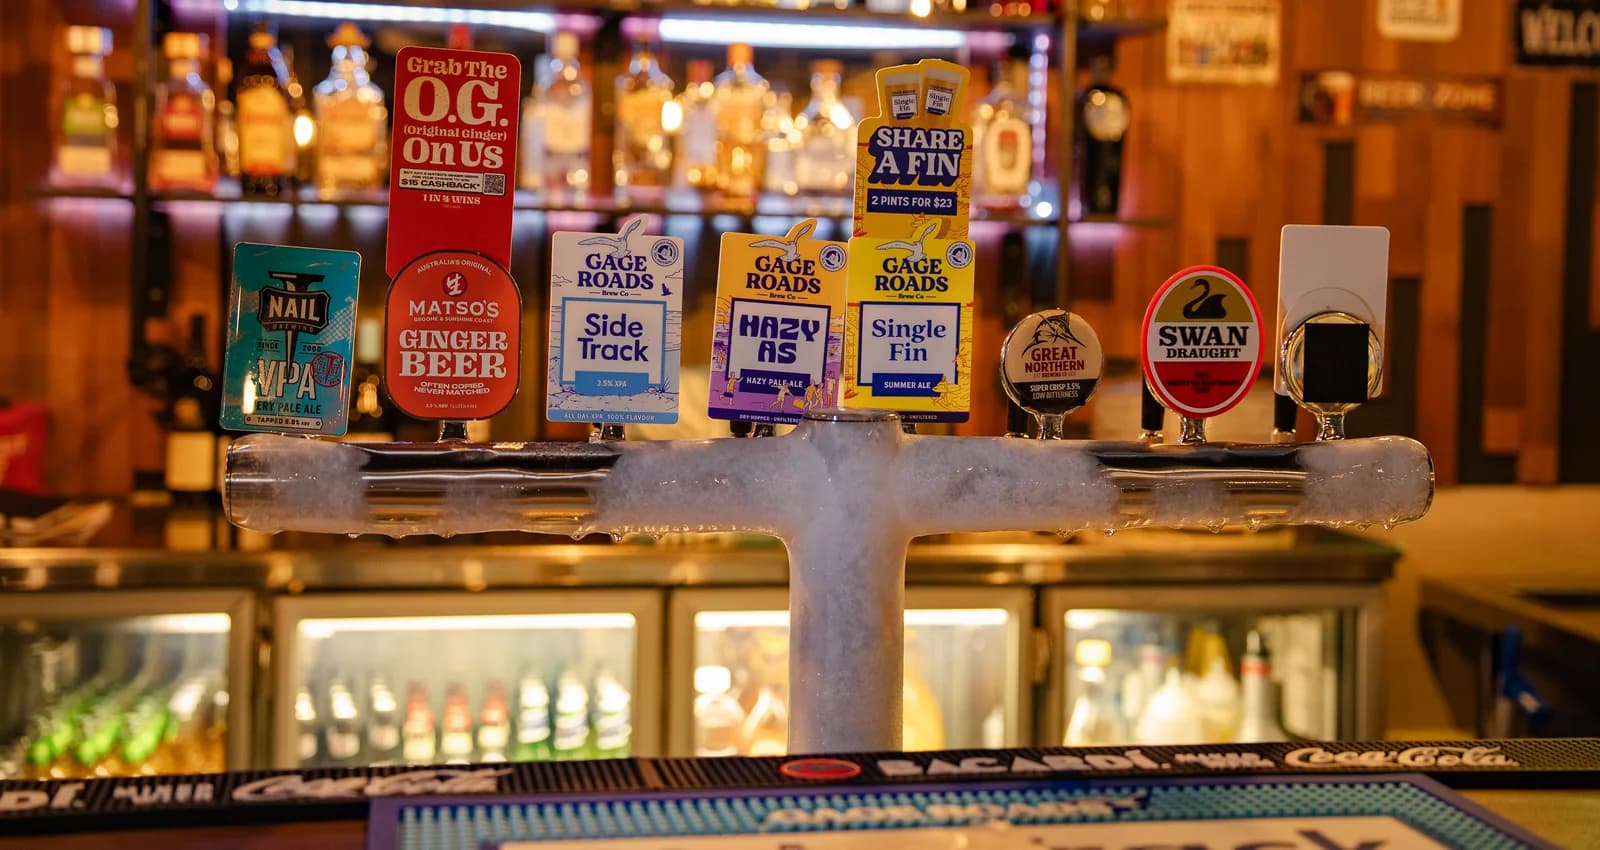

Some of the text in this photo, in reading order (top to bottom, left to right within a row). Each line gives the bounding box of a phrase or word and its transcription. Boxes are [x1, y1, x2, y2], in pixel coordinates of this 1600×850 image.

[407, 56, 508, 80] Grab The
[403, 76, 509, 127] O.G.
[403, 124, 507, 142] (Original Ginger)
[876, 128, 963, 150] SHARE
[403, 137, 504, 169] On Us
[876, 150, 960, 177] A FIN
[401, 178, 419, 186] $15
[429, 194, 441, 202] IN
[451, 195, 481, 205] WINS
[871, 195, 953, 209] 2 PINTS FOR $23
[416, 259, 493, 276] AUSTRALIA'S ORIGINAL
[585, 253, 648, 272] GAGE
[755, 256, 816, 276] GAGE
[882, 257, 942, 275] GAGE
[577, 271, 654, 290] ROADS
[745, 273, 821, 294] ROADS
[874, 275, 949, 292] ROADS
[268, 295, 321, 322] NAIL
[408, 300, 500, 319] MATSO'S
[583, 313, 644, 338] Side
[739, 314, 820, 342] HAZY
[871, 318, 946, 344] Single
[399, 329, 508, 351] GINGER
[1158, 326, 1249, 347] SWAN
[577, 338, 649, 362] Track
[757, 341, 797, 364] AS
[888, 343, 928, 362] Fin
[1031, 346, 1078, 362] GREAT
[1166, 348, 1242, 358] DRAUGHT
[399, 351, 507, 378] BEER
[1024, 360, 1085, 373] NORTHERN
[257, 359, 316, 400] VPA
[420, 381, 484, 390] OFTEN COPIED
[746, 377, 804, 389] HAZY PALE ALE
[883, 381, 931, 389] SUMMER ALE
[1030, 384, 1049, 393] SUPER
[1049, 383, 1066, 392] CRISP
[414, 386, 490, 396] NEVER MATCHED
[255, 400, 322, 415] ERY PALE ALE
